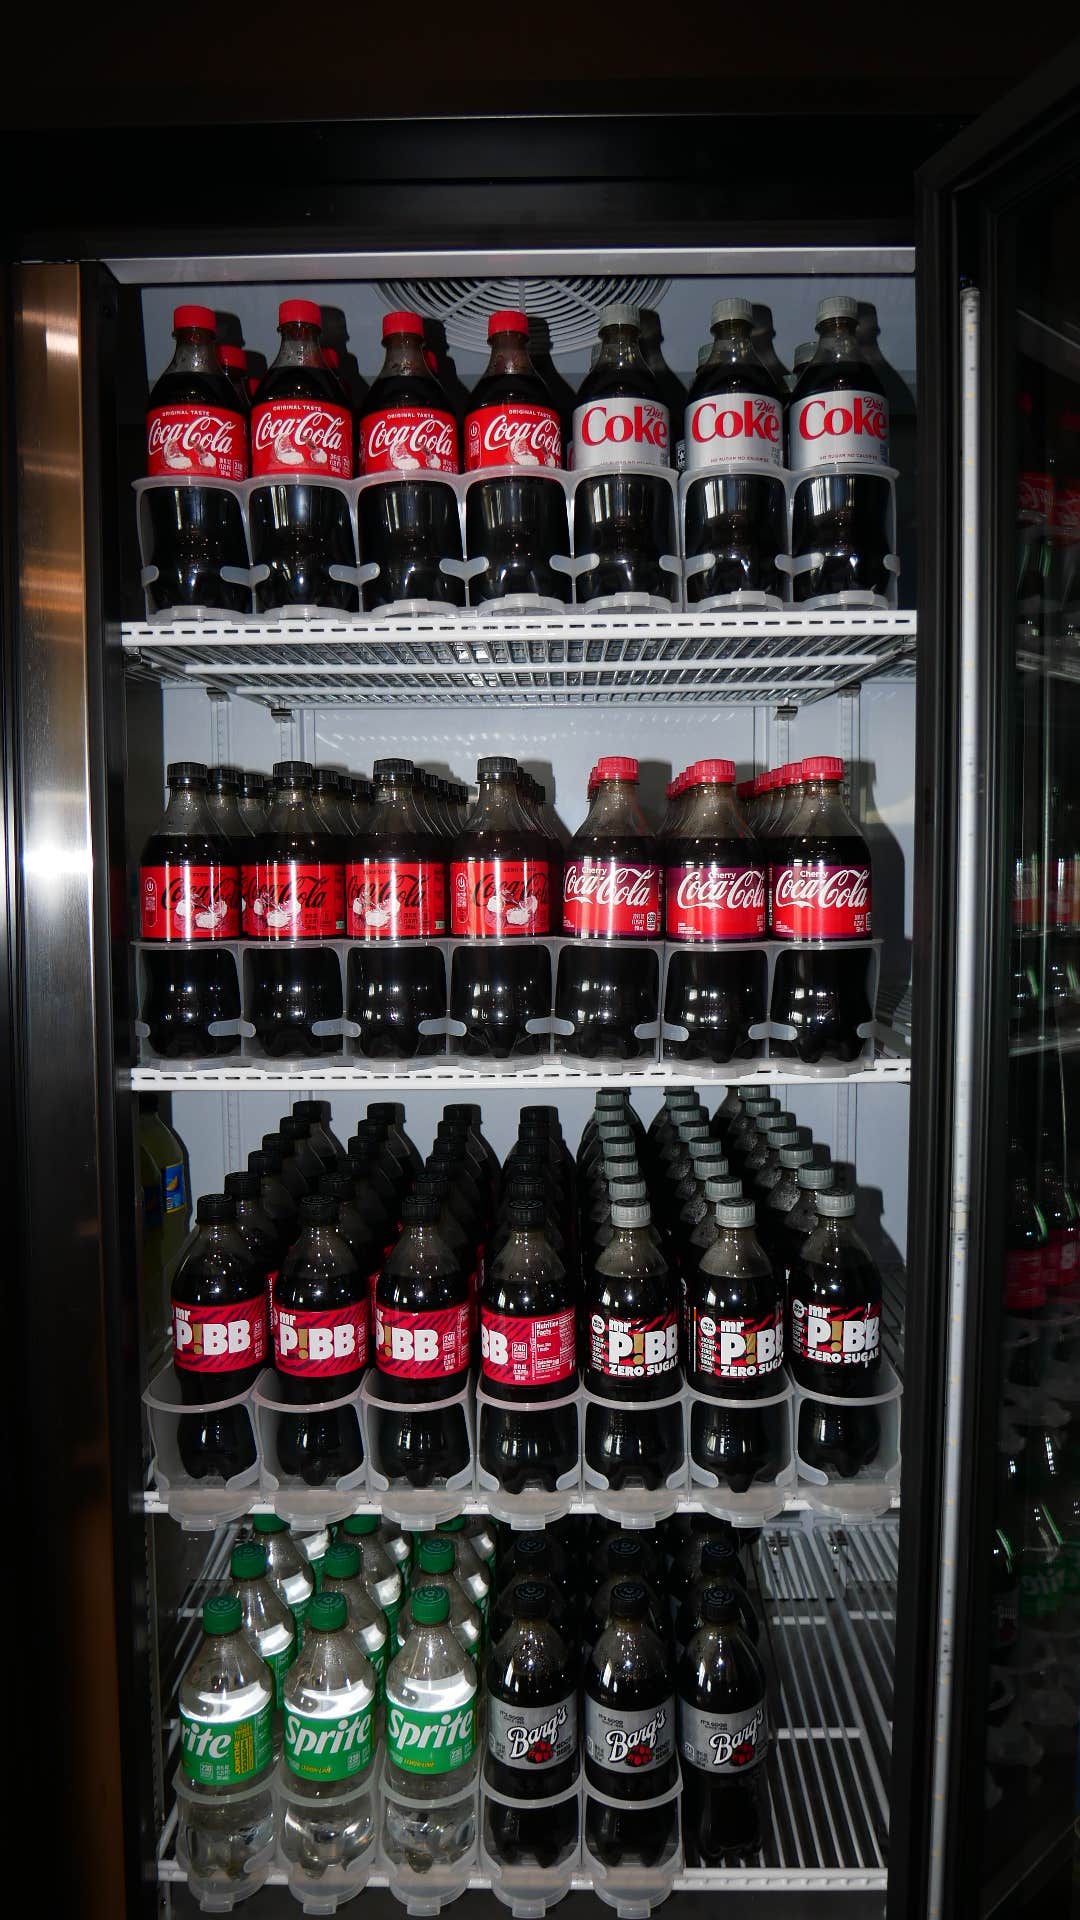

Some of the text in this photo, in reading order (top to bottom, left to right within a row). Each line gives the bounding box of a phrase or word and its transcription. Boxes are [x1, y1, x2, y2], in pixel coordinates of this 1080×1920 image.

[643, 404, 664, 418] Diet
[754, 398, 775, 413] Diet
[863, 396, 884, 411] Diet
[537, 411, 551, 419] TASTE
[692, 400, 779, 443] Coke
[799, 397, 887, 440] Coke
[256, 412, 344, 450] Coca-Cola
[581, 405, 667, 448] Coke
[149, 416, 236, 455] Coca-Cola
[369, 419, 453, 458] Coca-Cola
[582, 866, 607, 875] Cherry
[800, 870, 828, 878] Cherry
[563, 866, 655, 907] Coca-Cola
[775, 869, 870, 908] Coca-Cola
[175, 1307, 191, 1321] mr
[808, 1304, 831, 1318] mr
[280, 1312, 296, 1326] mr
[608, 1319, 631, 1332] mr
[720, 1320, 744, 1333] mr
[513, 1344, 526, 1352] 240
[807, 1348, 841, 1363] ZERO
[609, 1364, 645, 1377] ZERO
[720, 1365, 756, 1376] ZERO
[285, 1714, 371, 1757] Sprite
[388, 1708, 473, 1751] Sprite
[507, 1704, 567, 1759] Barq's
[605, 1709, 665, 1763] Barq's
[709, 1709, 764, 1765] Barq's
